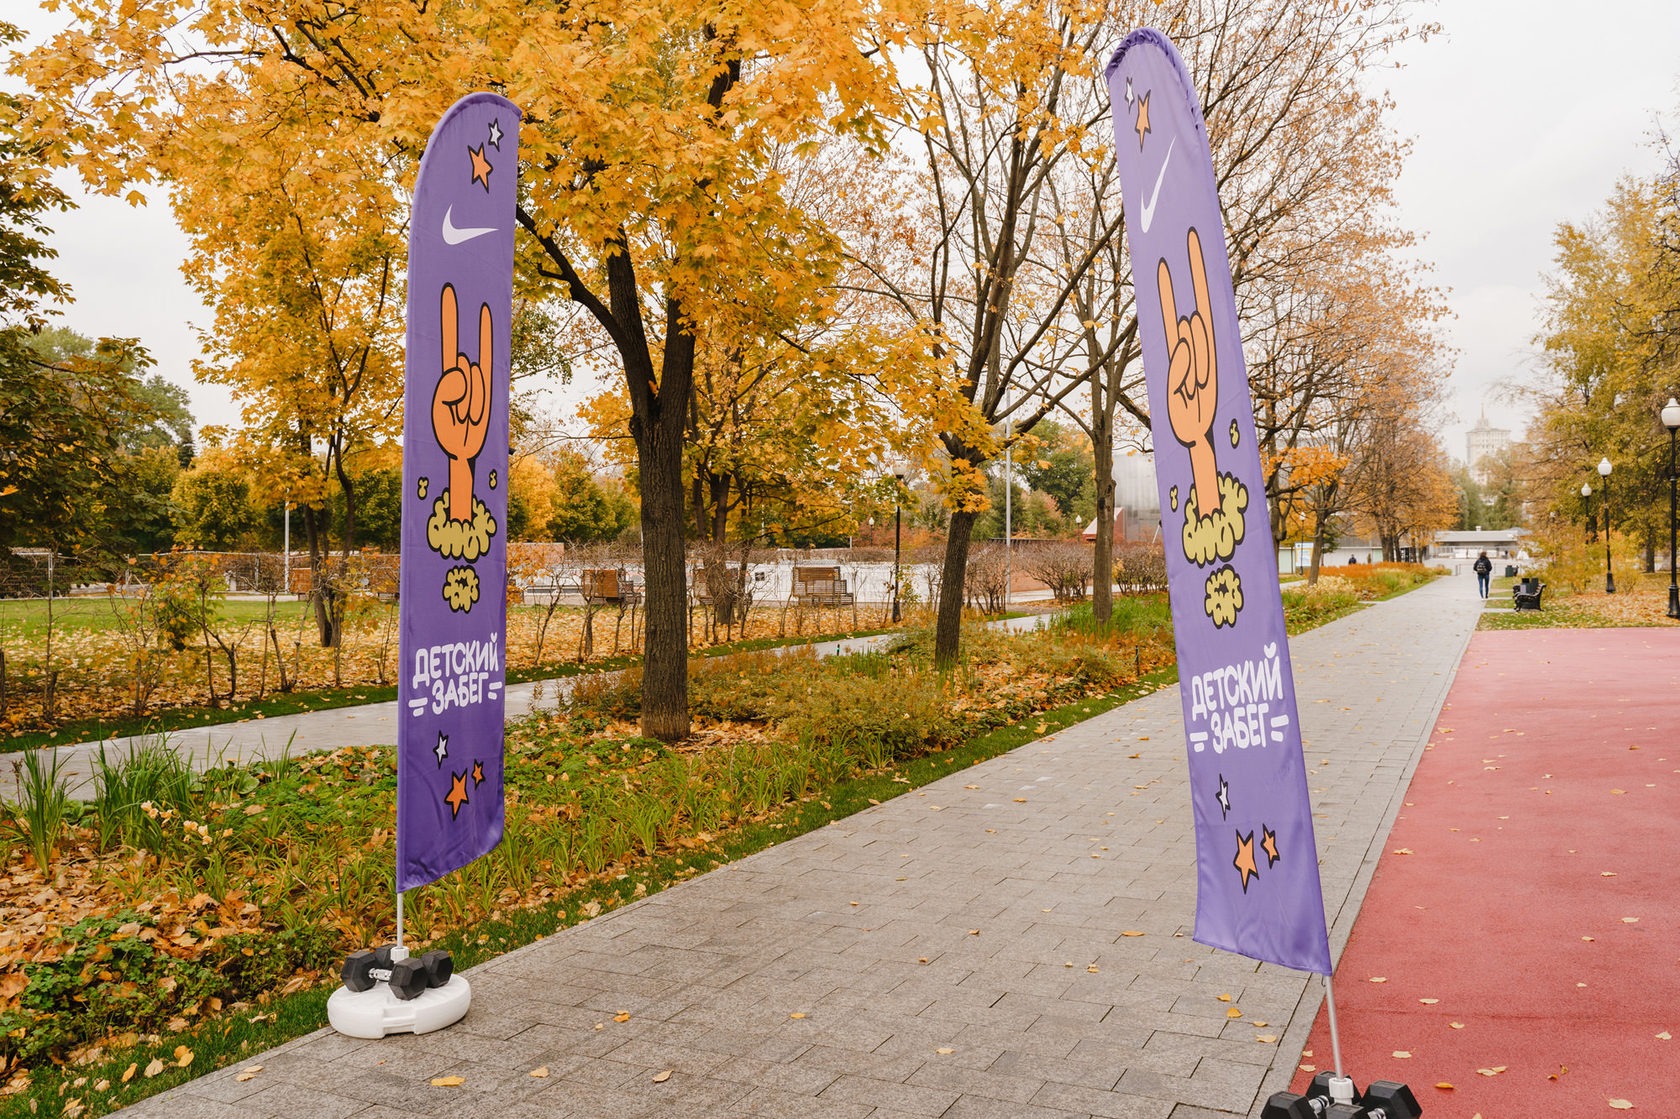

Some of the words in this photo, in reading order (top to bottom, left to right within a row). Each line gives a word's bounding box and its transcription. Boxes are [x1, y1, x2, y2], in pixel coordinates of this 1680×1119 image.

[413, 632, 498, 689] ДЕТСКИЙ
[1192, 642, 1283, 721] ДЕТСКИЙ
[432, 672, 489, 714] ЗАБЕГ
[1211, 703, 1269, 753] ЗАБЕГ
